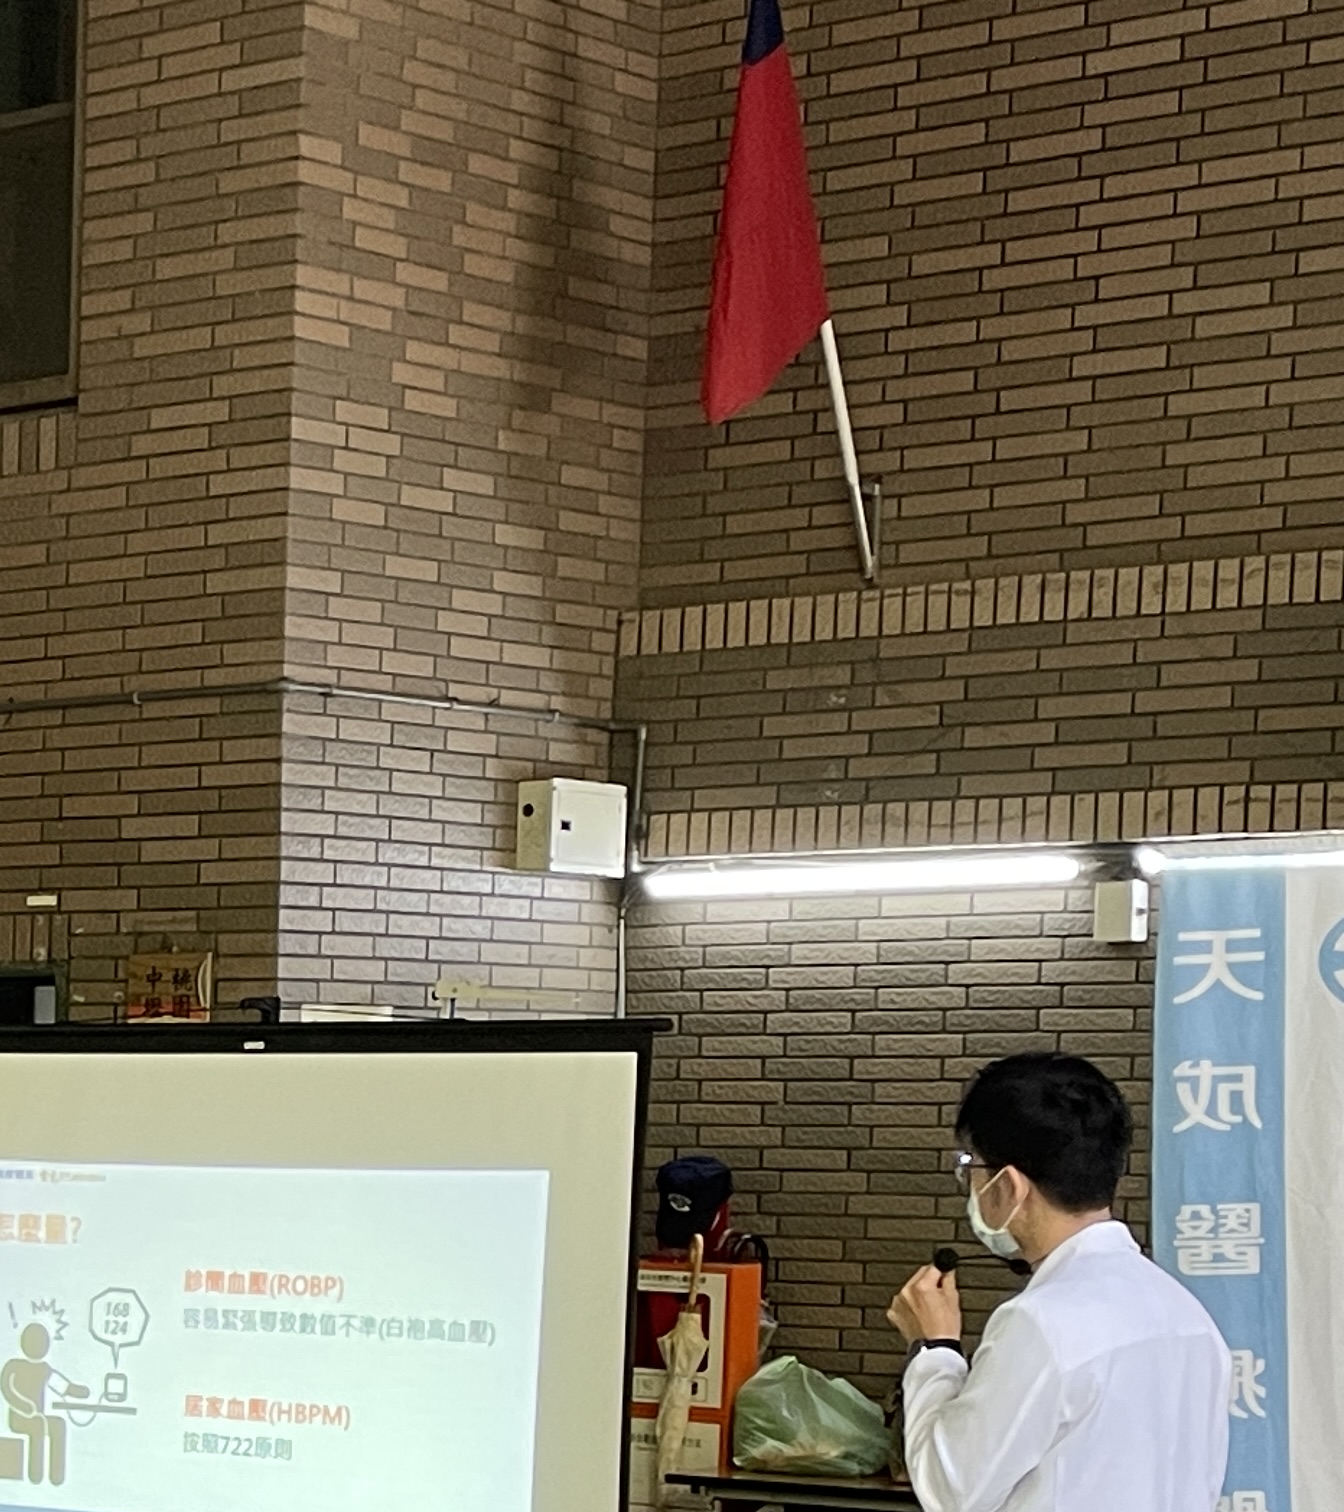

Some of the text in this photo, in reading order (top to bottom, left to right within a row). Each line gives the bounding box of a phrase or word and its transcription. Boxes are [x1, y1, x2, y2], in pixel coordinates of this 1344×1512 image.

[183, 1268, 345, 1303] 診間血壓(ROBP)
[184, 1394, 351, 1431] 居家血壓(HBPM)
